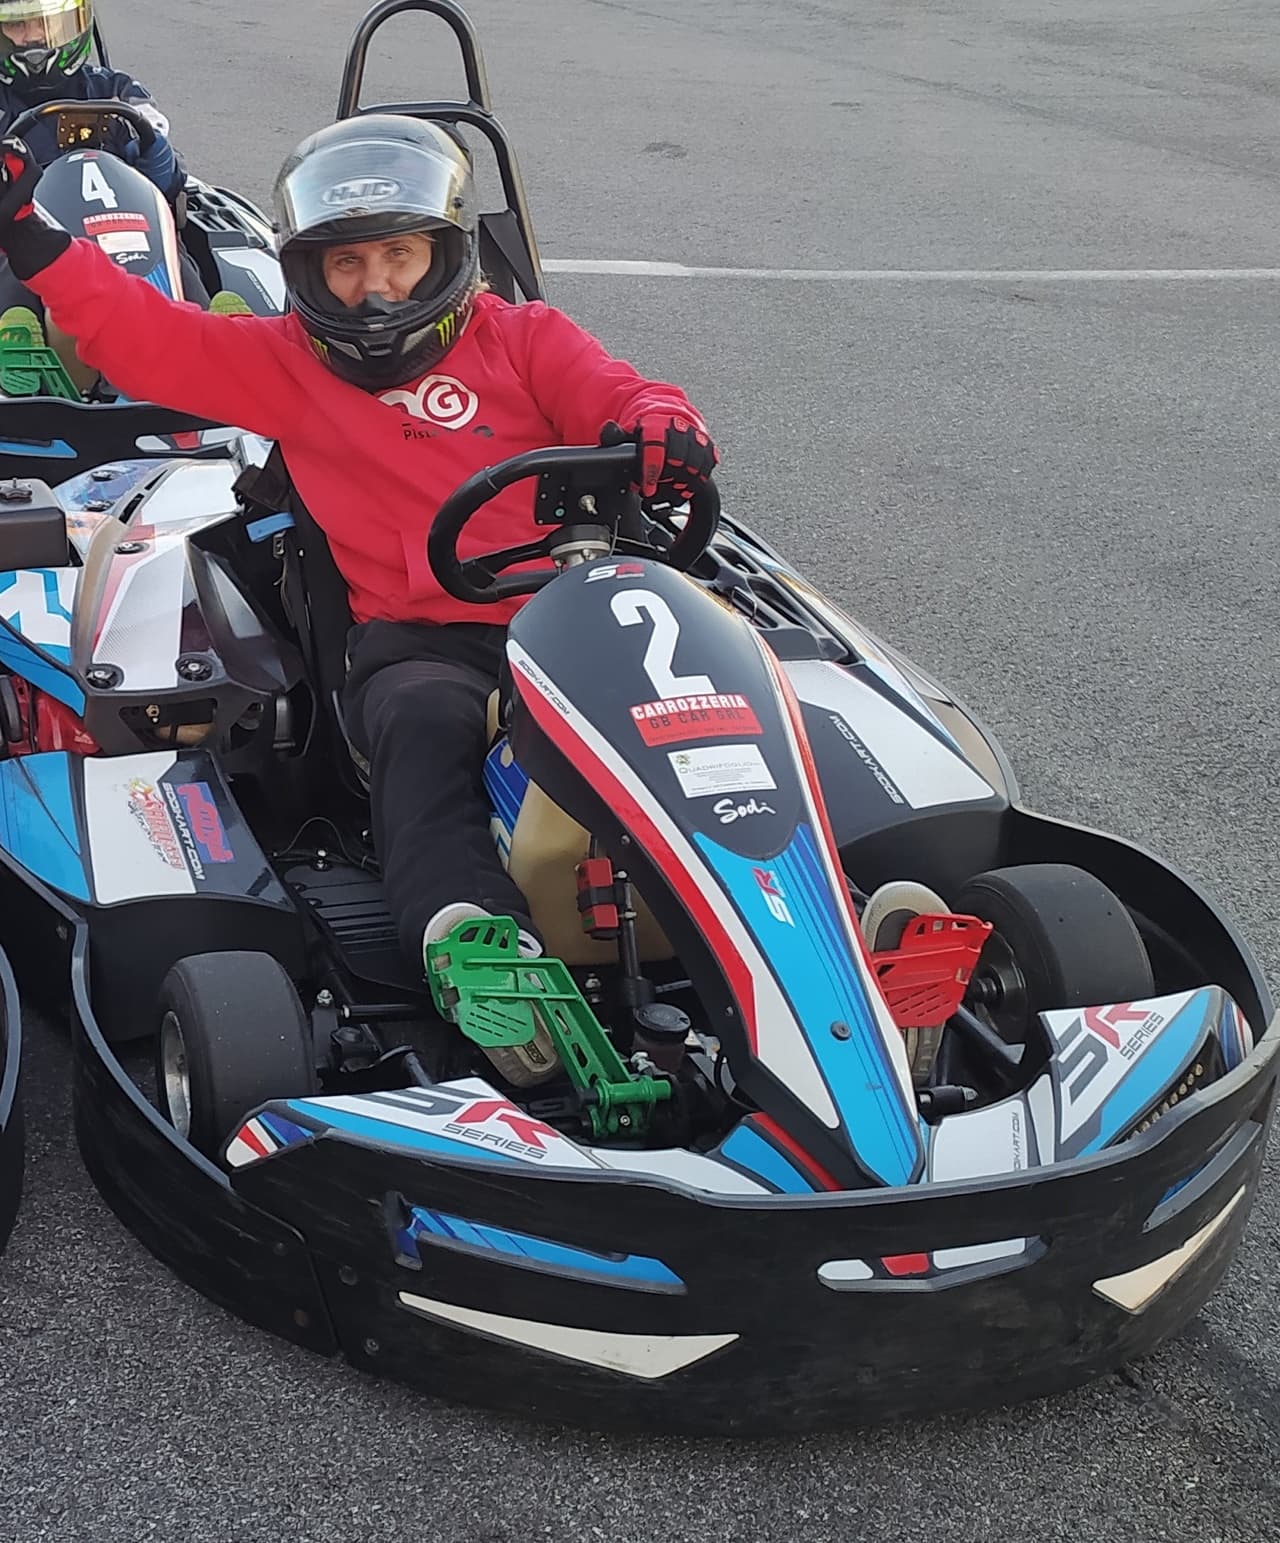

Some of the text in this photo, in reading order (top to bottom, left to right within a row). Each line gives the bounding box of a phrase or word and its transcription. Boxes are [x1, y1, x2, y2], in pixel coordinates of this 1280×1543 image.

[82, 161, 118, 208] 4
[328, 182, 393, 202] HJC
[610, 589, 716, 699] 2
[630, 694, 749, 720] CARROZZERIA
[677, 710, 710, 724] CAR
[713, 798, 776, 825] Sodi
[162, 782, 206, 880] SODIKART.COM
[1119, 1011, 1165, 1061] SERIES
[442, 1122, 548, 1160] SERIES
